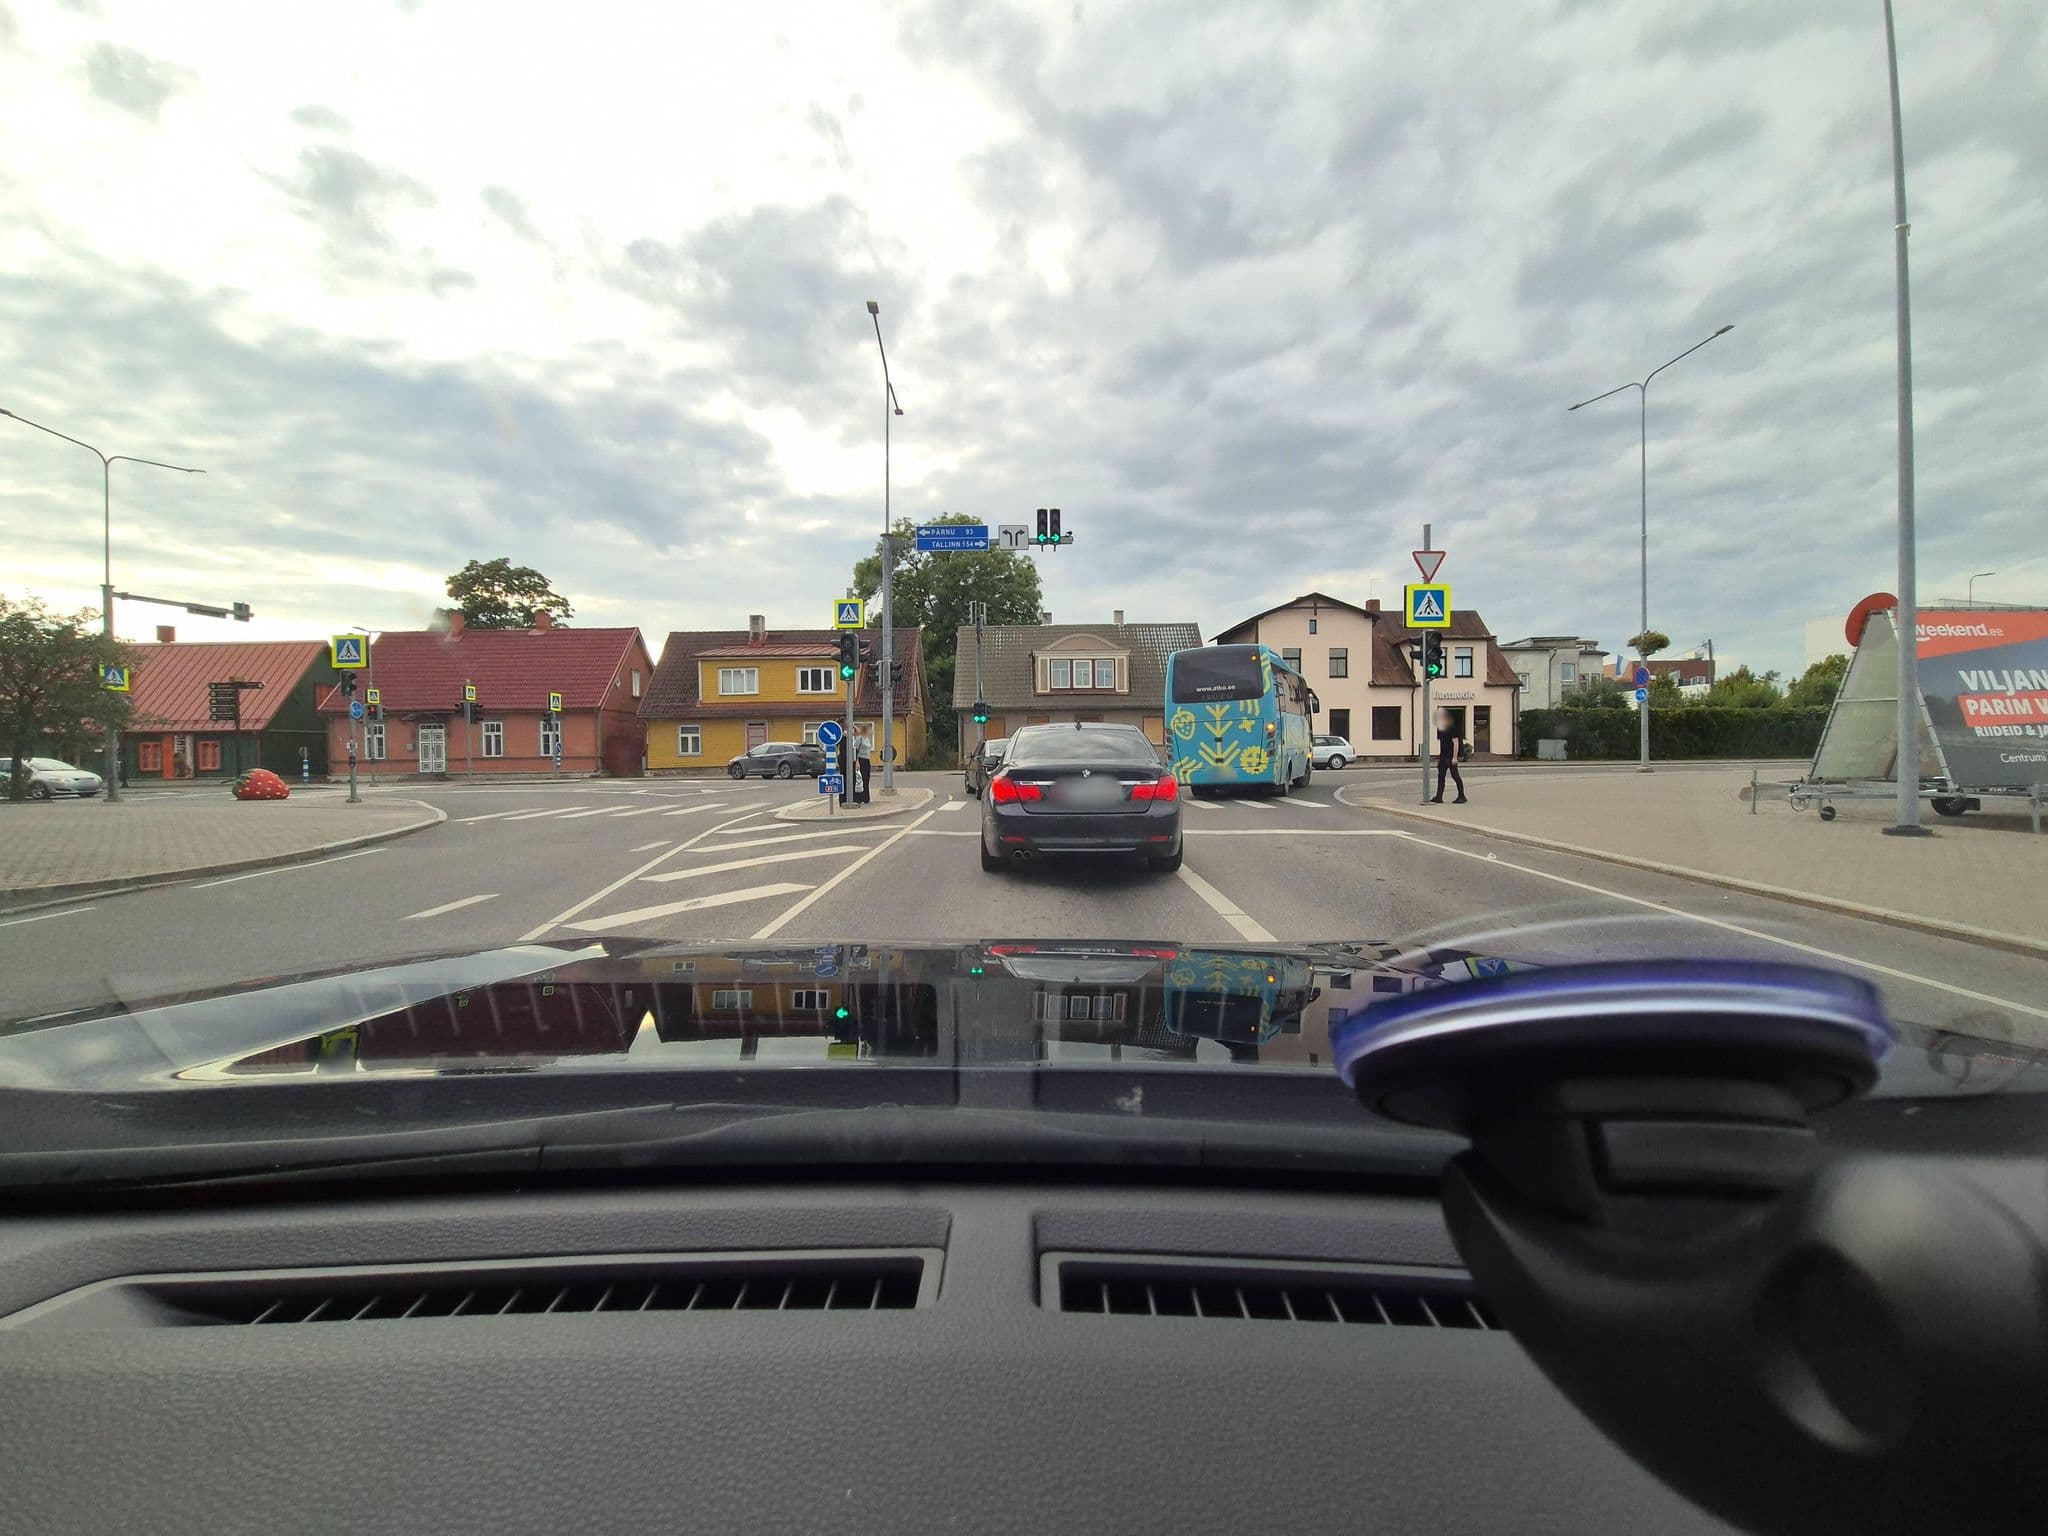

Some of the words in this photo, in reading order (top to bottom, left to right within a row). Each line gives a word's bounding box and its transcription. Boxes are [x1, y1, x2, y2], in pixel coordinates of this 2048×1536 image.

[931, 527, 955, 536] PÄRNU
[965, 528, 974, 536] 93
[932, 540, 961, 548] TALLINN
[962, 540, 974, 548] 154
[1196, 684, 1236, 693] www.atko.ee
[1965, 698, 2033, 715] PARIM
[1974, 725, 2023, 737] RIIDEID
[2025, 725, 2036, 736] &
[2000, 752, 2047, 763] Centrumi
